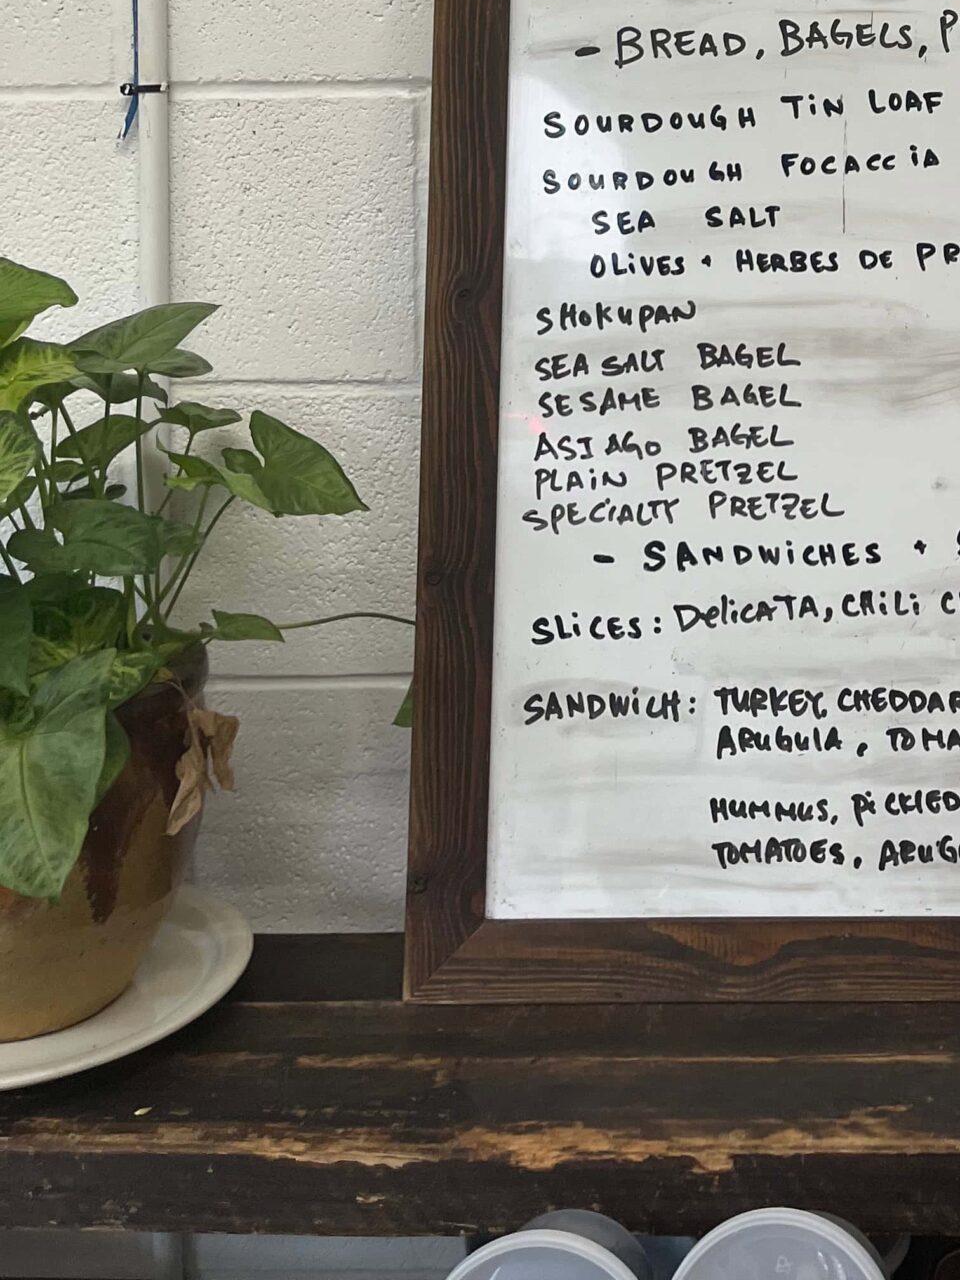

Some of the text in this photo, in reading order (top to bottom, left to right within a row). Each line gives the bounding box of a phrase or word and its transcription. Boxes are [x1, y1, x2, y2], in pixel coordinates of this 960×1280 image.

[778, 18, 928, 59] BAGELS,
[543, 103, 757, 139] SOURDOUGH
[867, 88, 944, 115] LOAF
[542, 160, 743, 195] SOURDOUGH
[591, 209, 656, 236] SEA
[704, 205, 781, 229] SALT
[735, 248, 839, 274] HERBES
[858, 249, 893, 270] DE
[535, 299, 697, 336] SHOKUPAN
[534, 352, 590, 382] SEA
[600, 348, 666, 377] SALT
[696, 341, 802, 371] BAGEL
[538, 386, 661, 419] SESAME
[690, 382, 803, 412] BAGEL
[687, 422, 795, 454] BAGEL
[655, 458, 799, 492] PRETZEL
[708, 489, 846, 521] PRETZEL
[709, 797, 839, 826] HUMMUS,
